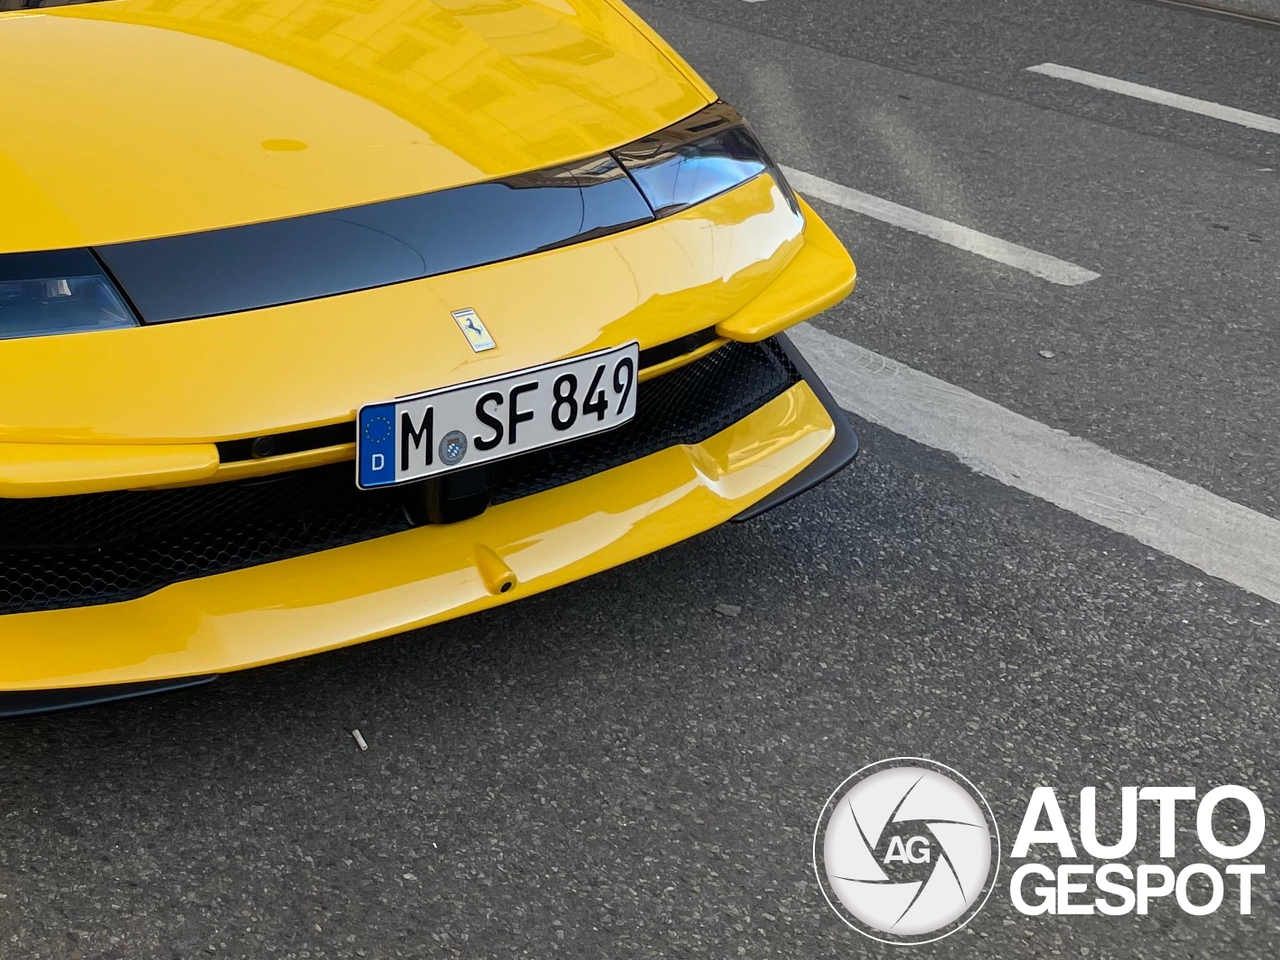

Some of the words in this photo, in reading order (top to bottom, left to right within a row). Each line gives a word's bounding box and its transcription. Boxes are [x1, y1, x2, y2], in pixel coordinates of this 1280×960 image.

[401, 404, 434, 471] M
[473, 381, 539, 451] SF
[551, 356, 634, 431] 849
[371, 453, 385, 471] D
